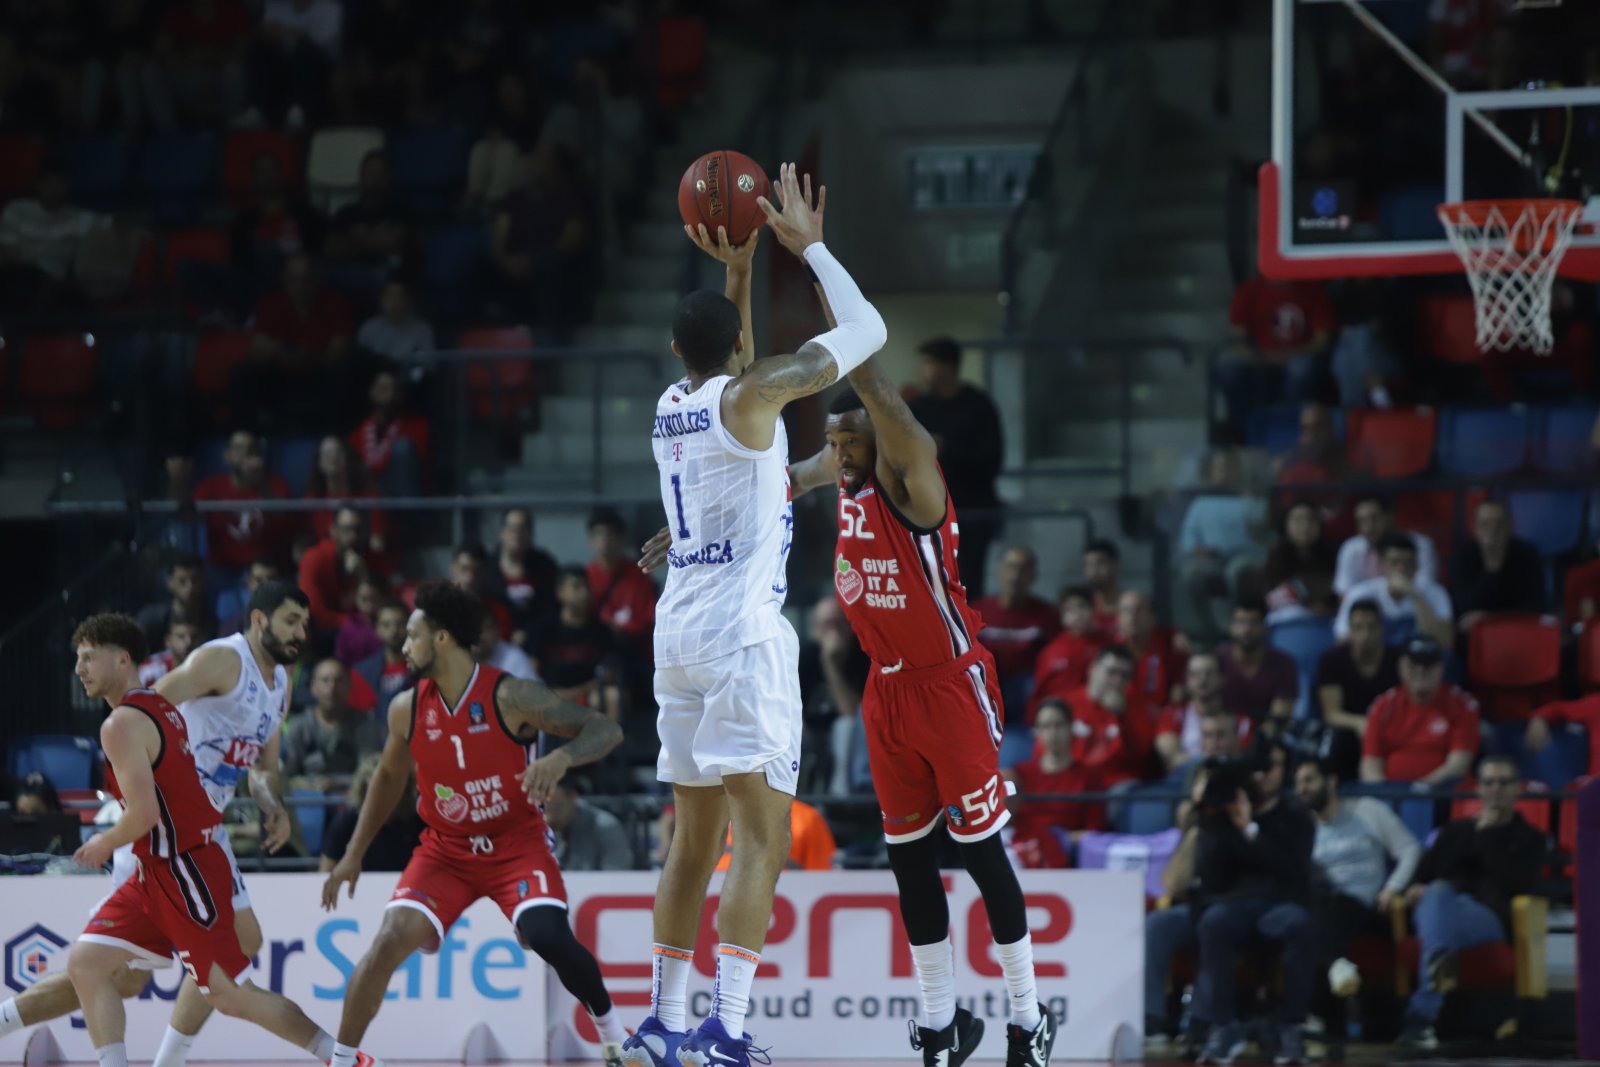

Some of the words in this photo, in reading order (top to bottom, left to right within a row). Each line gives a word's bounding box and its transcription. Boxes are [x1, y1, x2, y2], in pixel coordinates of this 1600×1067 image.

[671, 474, 691, 539] 1
[840, 498, 875, 539] 52
[862, 558, 899, 575] GIVE
[867, 576, 881, 591] IT
[886, 577, 899, 592] A
[865, 593, 907, 609] SHOT
[450, 735, 466, 769] 1
[464, 775, 503, 795] GIVE
[472, 794, 486, 808] IT
[491, 791, 503, 803] A
[961, 774, 999, 826] 52
[470, 800, 510, 823] SHOT
[532, 869, 548, 894] 1
